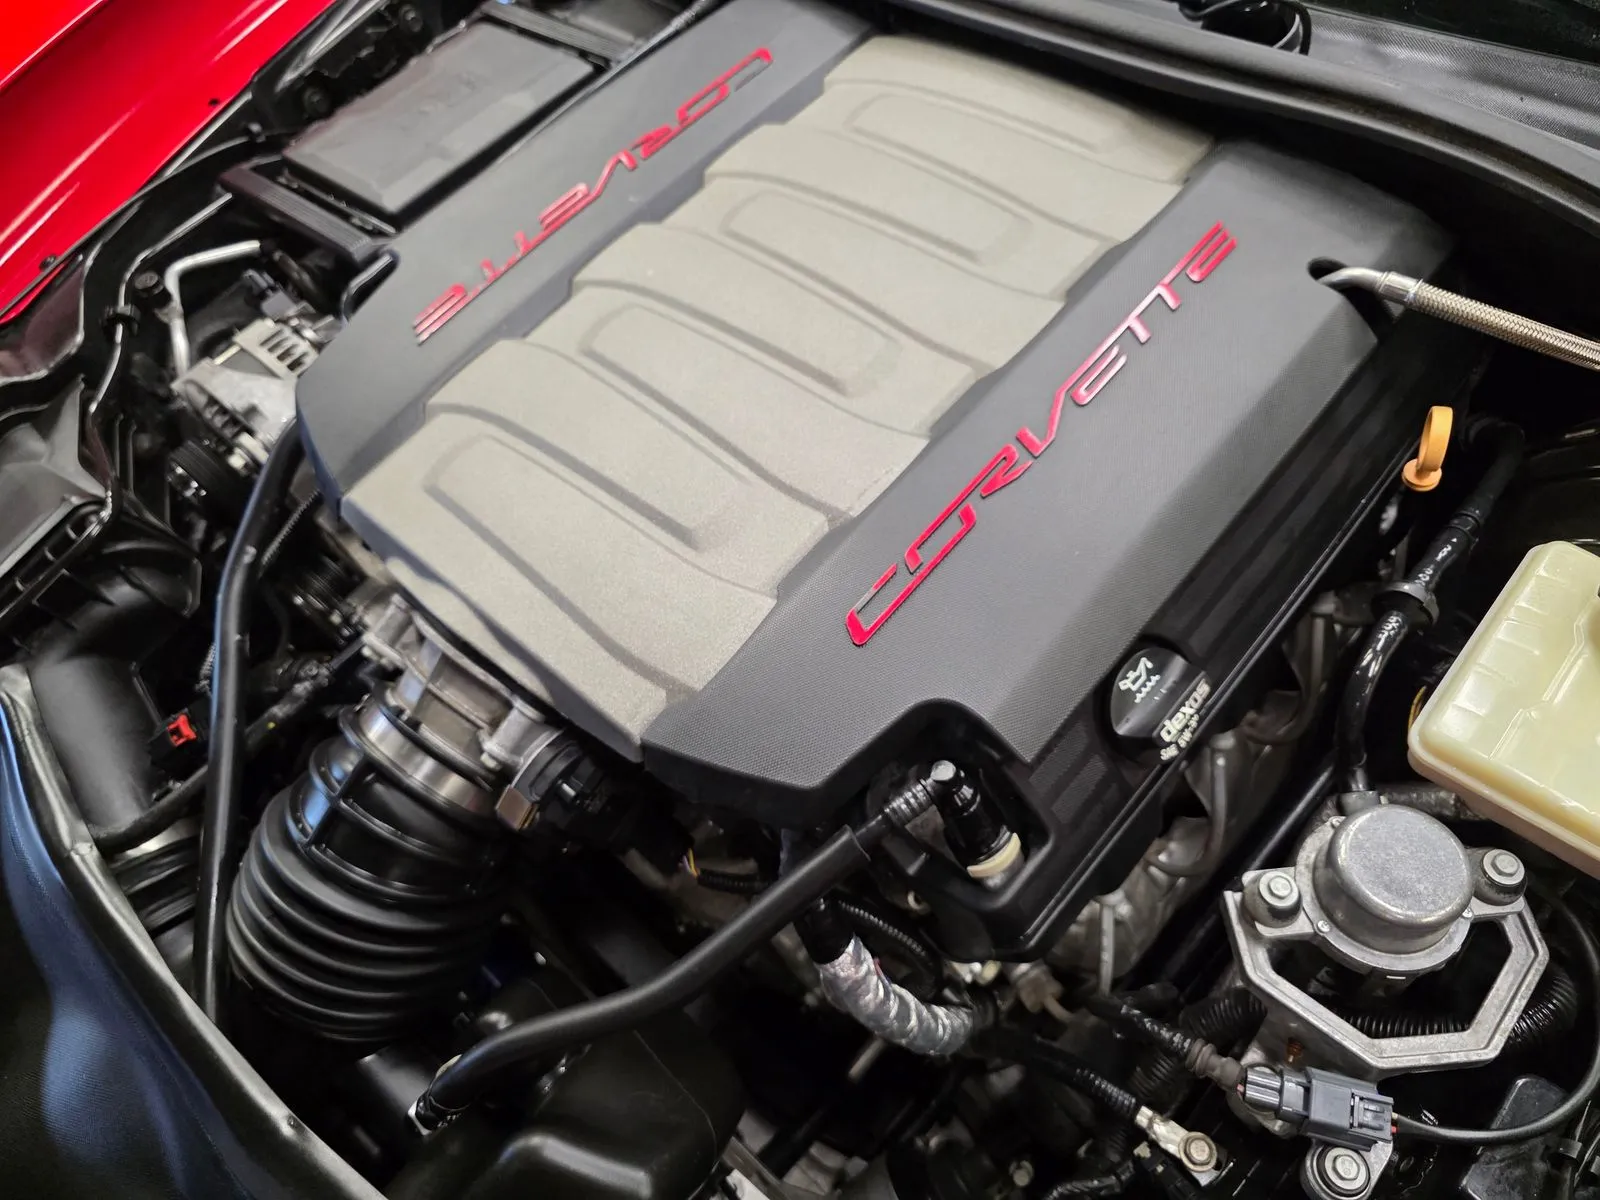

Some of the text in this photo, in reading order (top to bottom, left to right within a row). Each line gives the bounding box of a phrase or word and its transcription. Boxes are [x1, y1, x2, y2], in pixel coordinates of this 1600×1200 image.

[412, 47, 773, 346] CORVETTE
[846, 221, 1238, 646] CORVETTE
[1160, 678, 1211, 743] dexos
